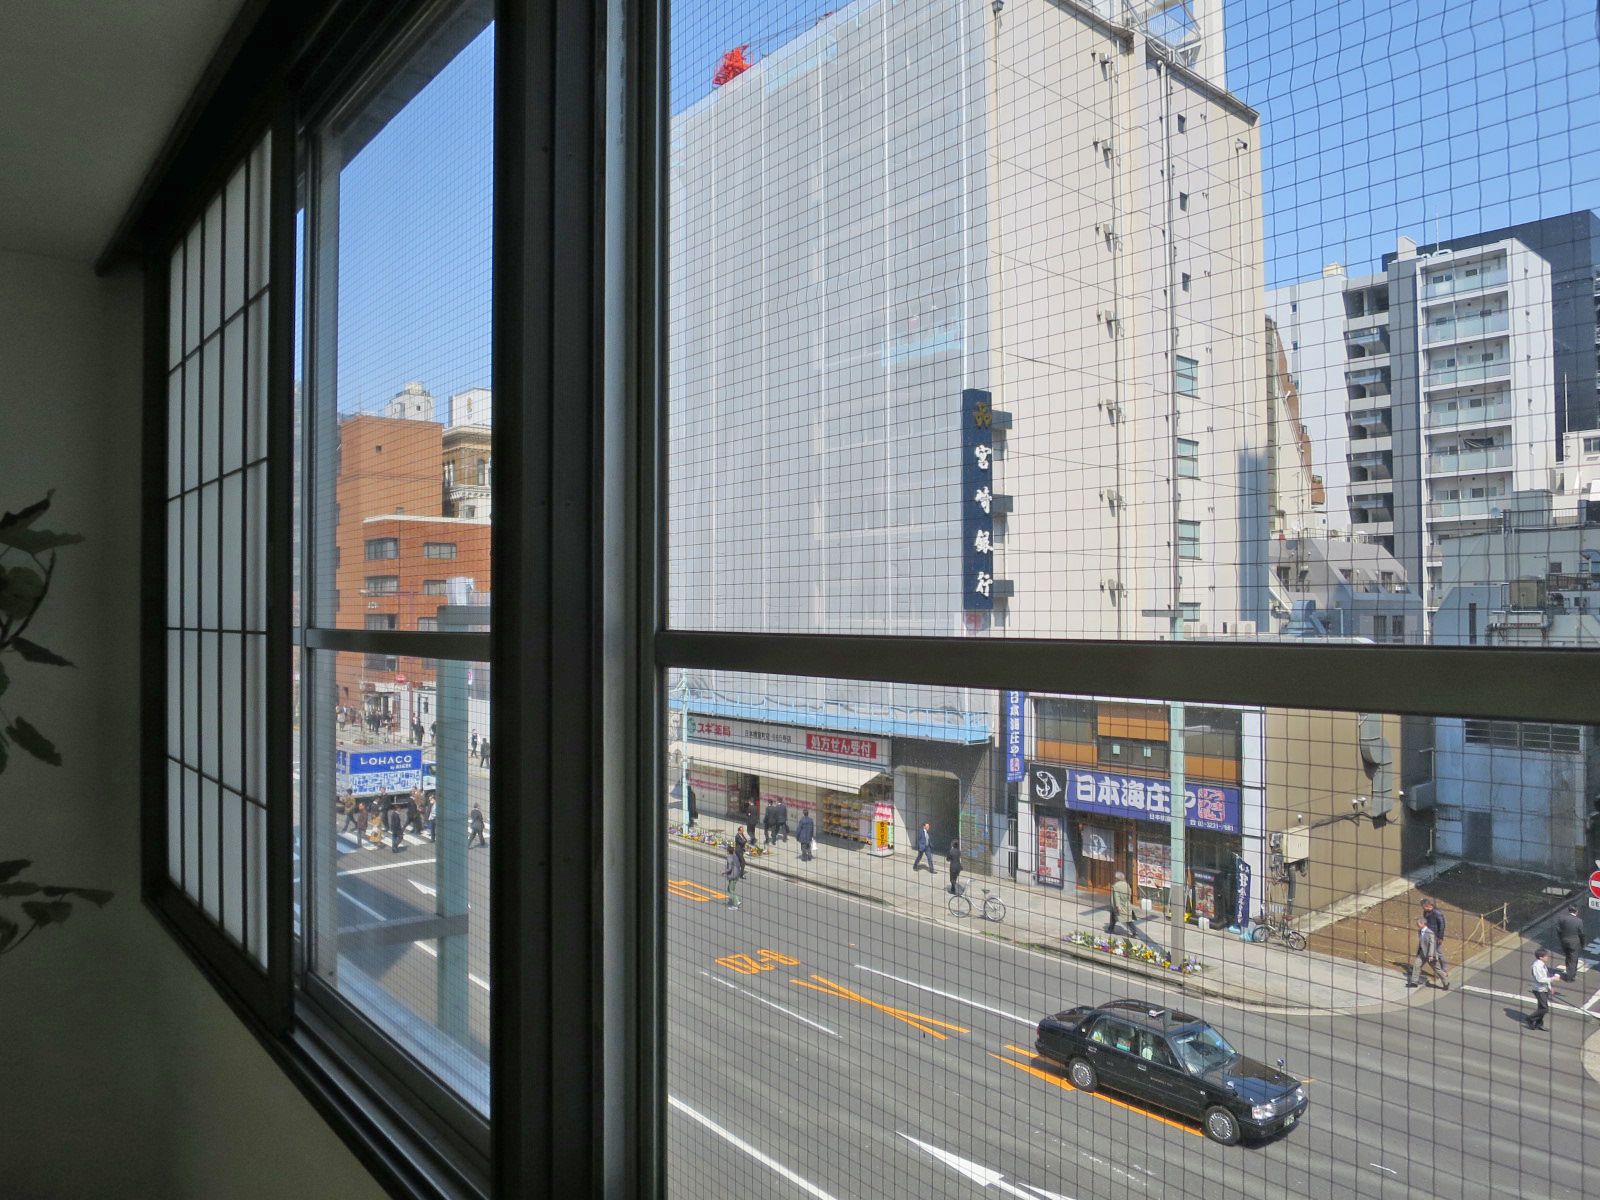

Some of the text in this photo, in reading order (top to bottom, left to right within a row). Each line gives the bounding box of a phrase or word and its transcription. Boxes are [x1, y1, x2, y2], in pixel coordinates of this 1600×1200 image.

[697, 722, 731, 737] スギ薬局
[811, 735, 871, 758] 処方せん受付
[360, 755, 412, 765] LOHACO
